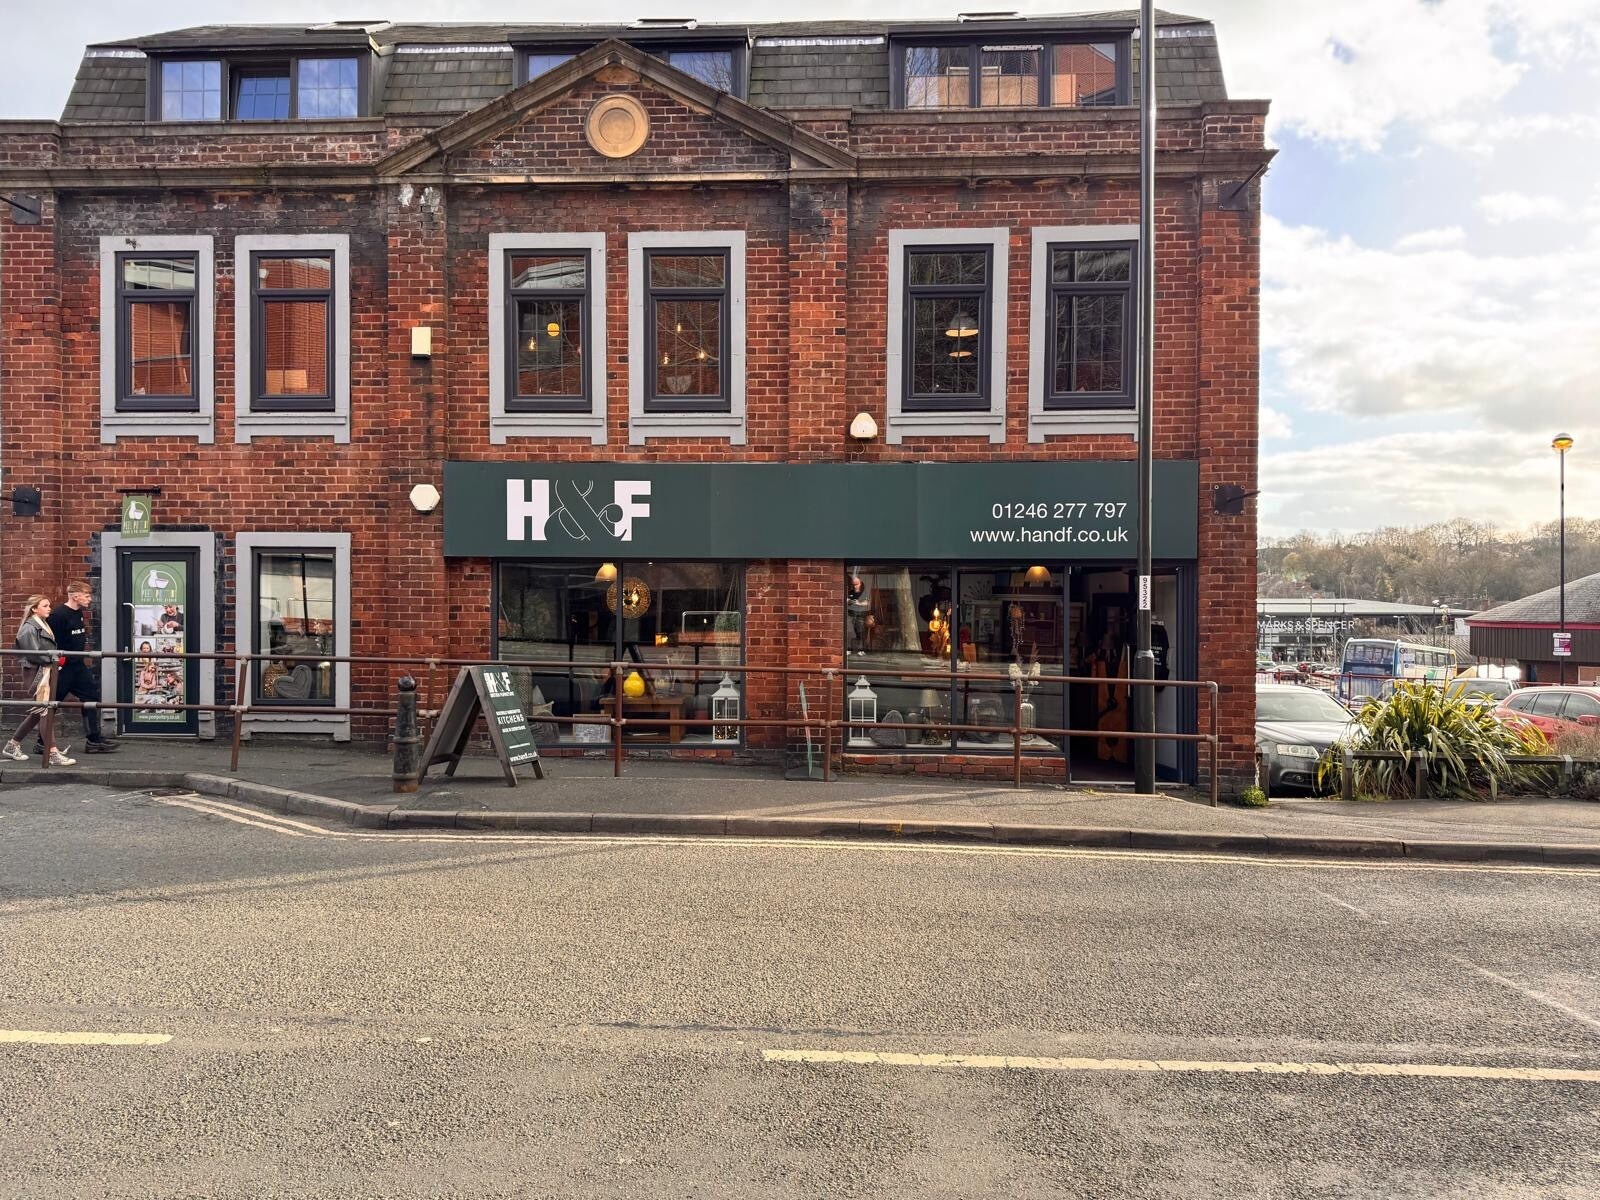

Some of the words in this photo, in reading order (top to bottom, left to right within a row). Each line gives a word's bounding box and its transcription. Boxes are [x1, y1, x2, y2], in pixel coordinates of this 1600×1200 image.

[506, 479, 652, 541] H&F
[992, 503, 1048, 519] 01246
[1053, 503, 1087, 519] 277
[1093, 503, 1128, 519] 797
[970, 526, 1129, 543] www.handf.co.uk
[1257, 620, 1294, 630] MARKS
[1304, 620, 1355, 630] SPENCER
[497, 713, 525, 725] KITCHENS
